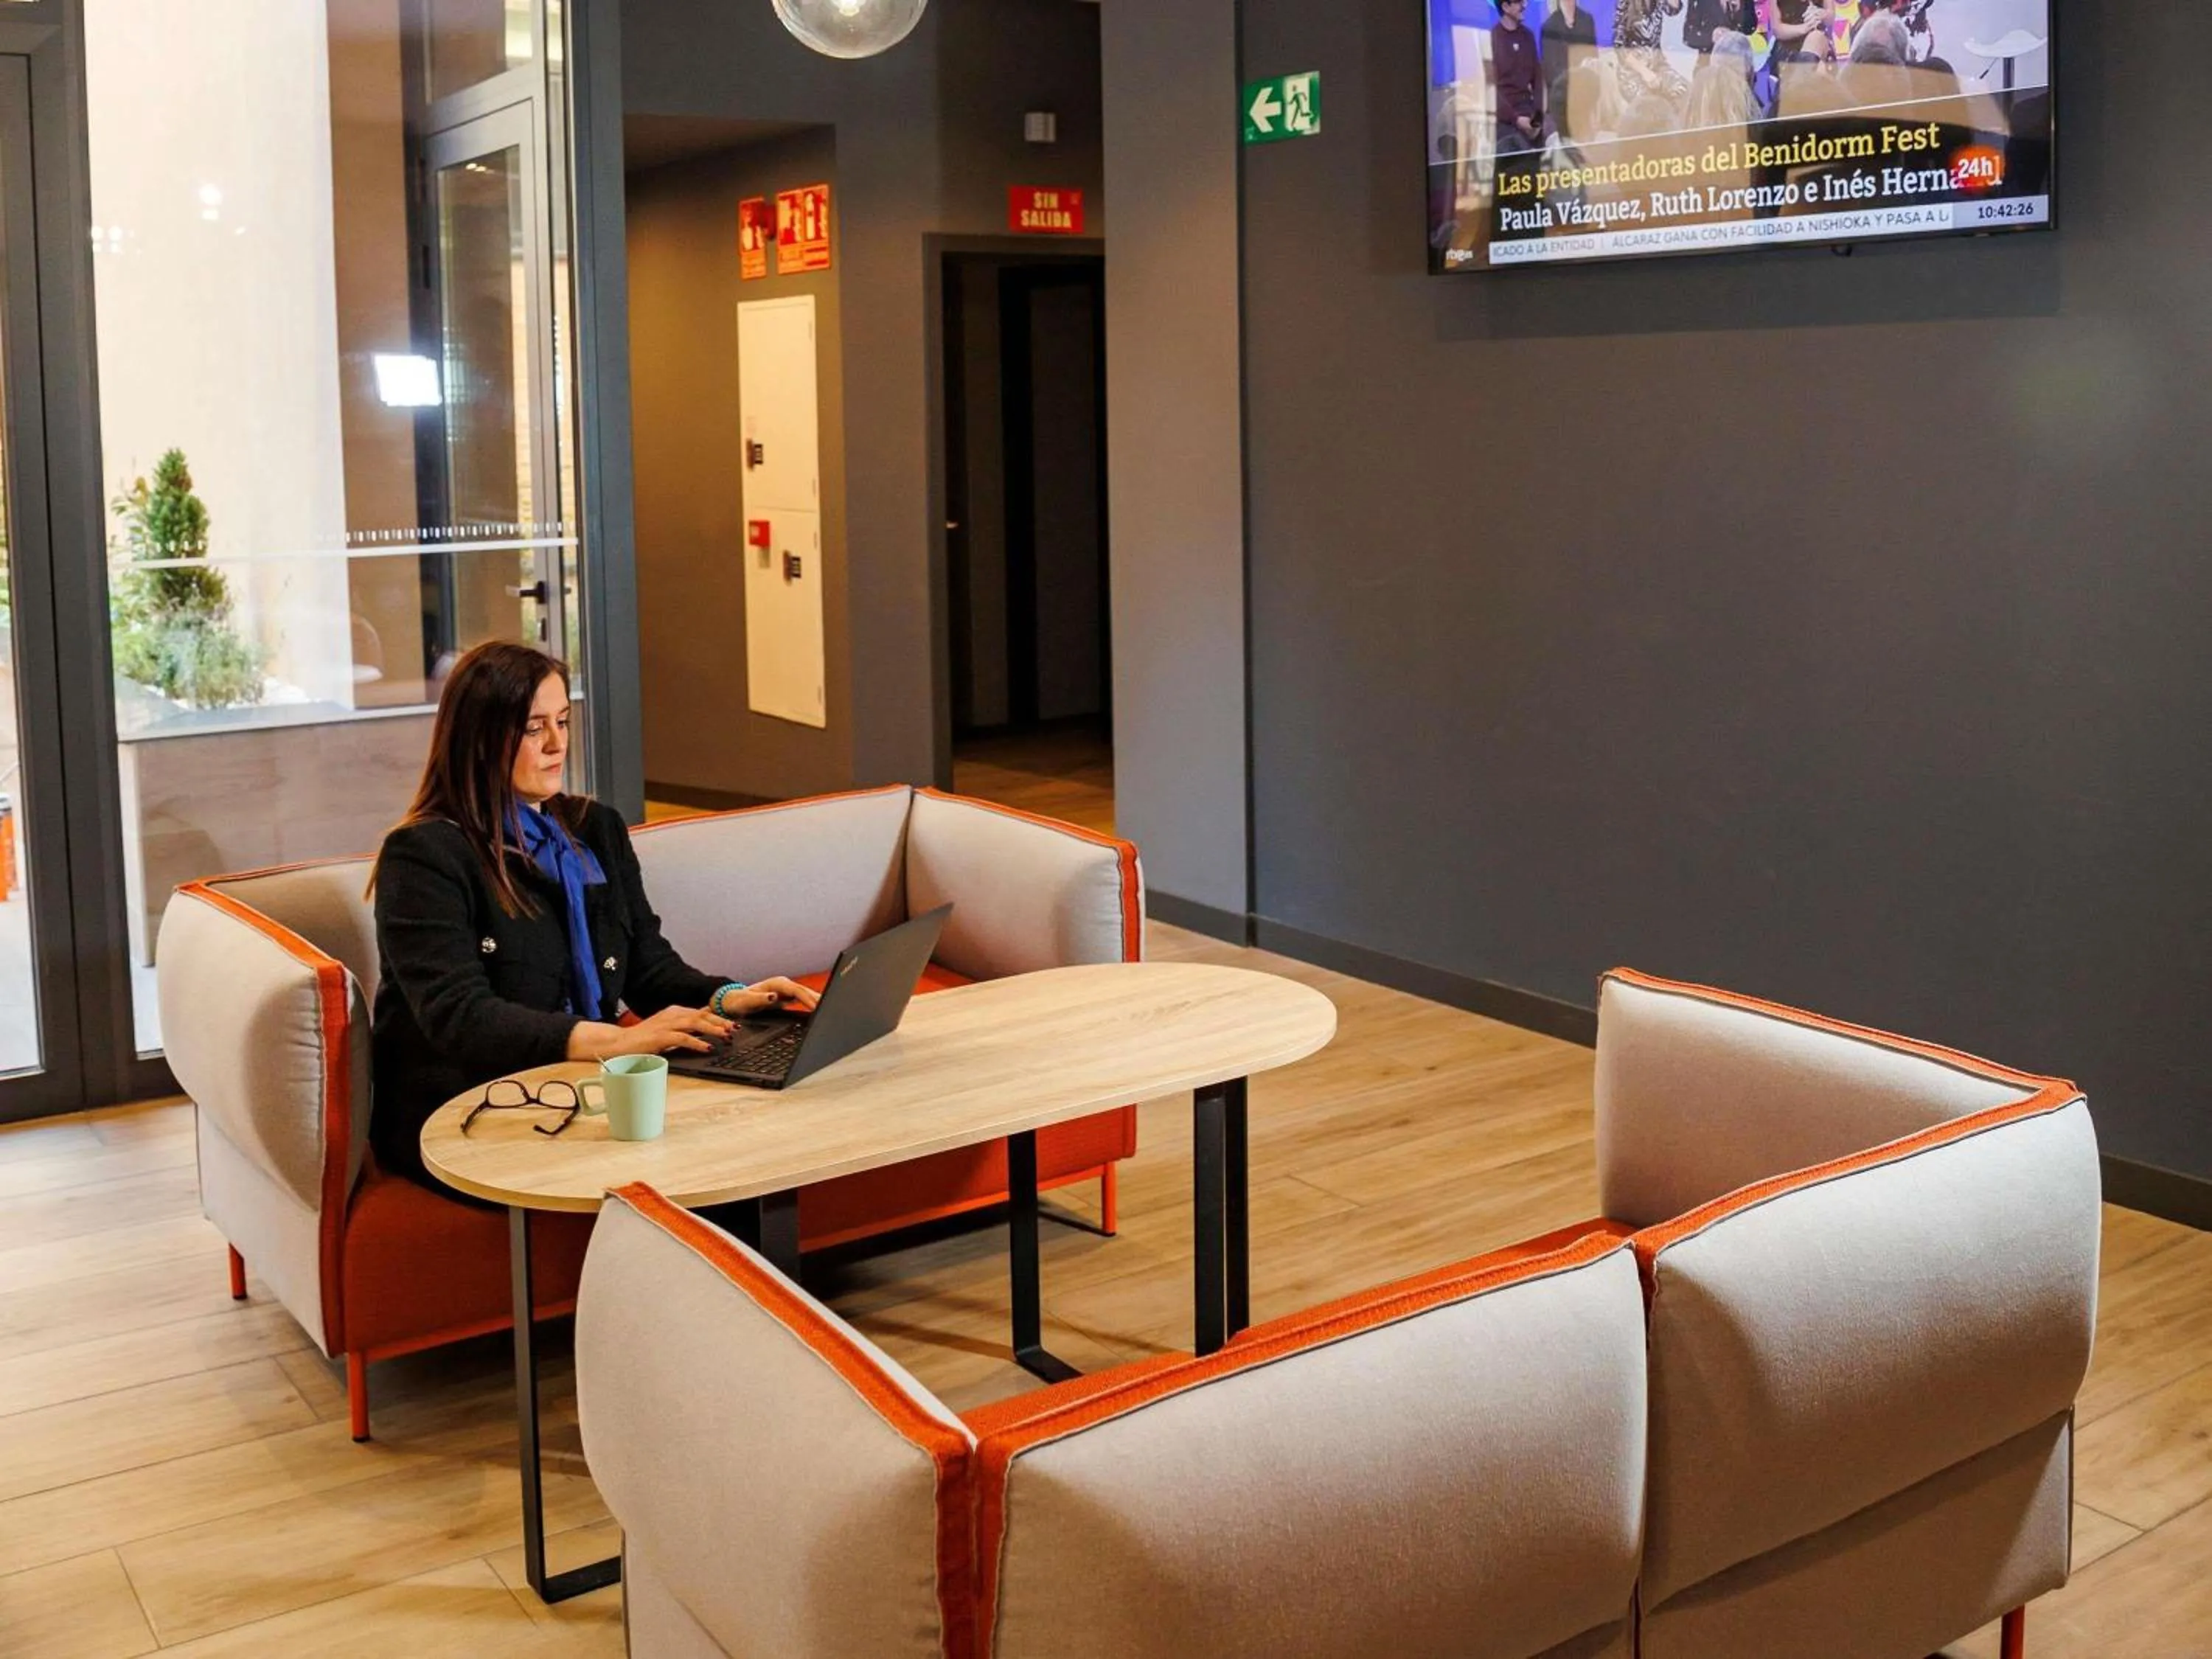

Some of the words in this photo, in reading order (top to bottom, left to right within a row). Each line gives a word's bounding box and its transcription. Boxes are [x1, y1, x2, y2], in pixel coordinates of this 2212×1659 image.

[1498, 171, 1531, 195] Las
[1536, 154, 1695, 198] presentadoras
[1701, 144, 1739, 173] del
[1744, 133, 1875, 170] Benidorm
[1881, 122, 1941, 154] Fest
[1958, 156, 1994, 179] 24h
[1034, 192, 1059, 209] SIN
[1500, 202, 1554, 231] Paula
[1556, 198, 1646, 229] Vázquez,
[1650, 187, 1703, 217] Ruth
[1707, 184, 1799, 212] Lorenzo
[1804, 181, 1818, 203] e
[1823, 168, 1877, 201] Inés
[1020, 209, 1072, 228] SALIDA
[1978, 203, 2034, 219] 10:42:26
[1612, 232, 1660, 248] ALCARAZ
[1663, 229, 1698, 243] GANA
[1701, 227, 1728, 240] CON
[1732, 221, 1793, 238] FACILIDAD
[1796, 220, 1806, 232] A
[1809, 215, 1871, 232] NISHIOKA
[1874, 215, 1883, 226] Y
[1887, 211, 1921, 225] PASA
[1925, 209, 1935, 222] A
[1551, 239, 1594, 252] ENTIDAD
